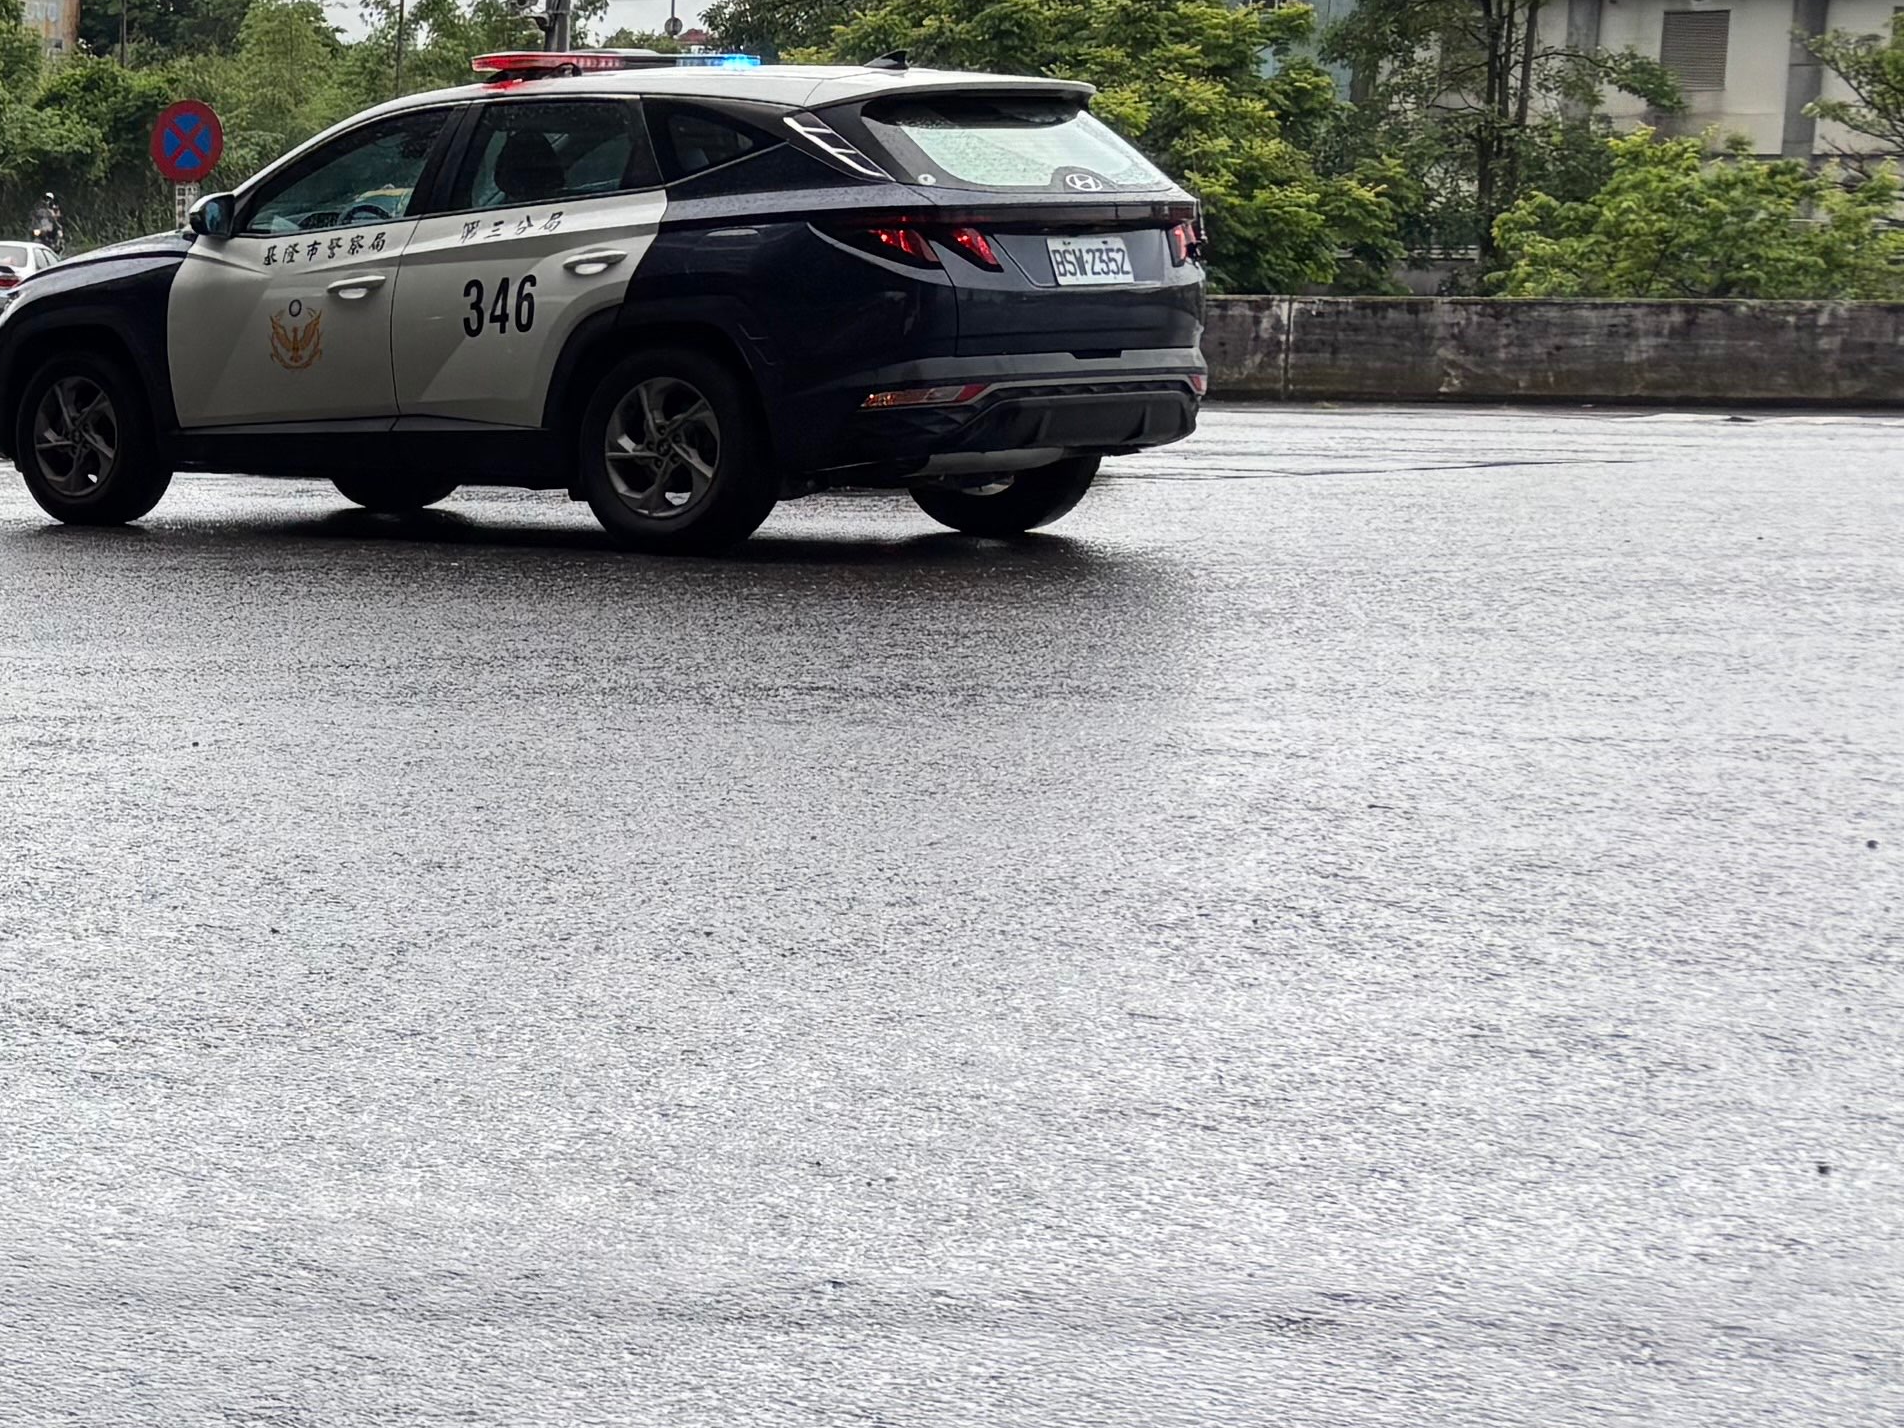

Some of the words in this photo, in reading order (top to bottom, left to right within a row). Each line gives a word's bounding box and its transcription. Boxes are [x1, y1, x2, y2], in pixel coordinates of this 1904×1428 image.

[262, 231, 387, 266] 基隆市警察局
[1051, 247, 1131, 277] BSW-2352
[462, 274, 537, 338] 346
